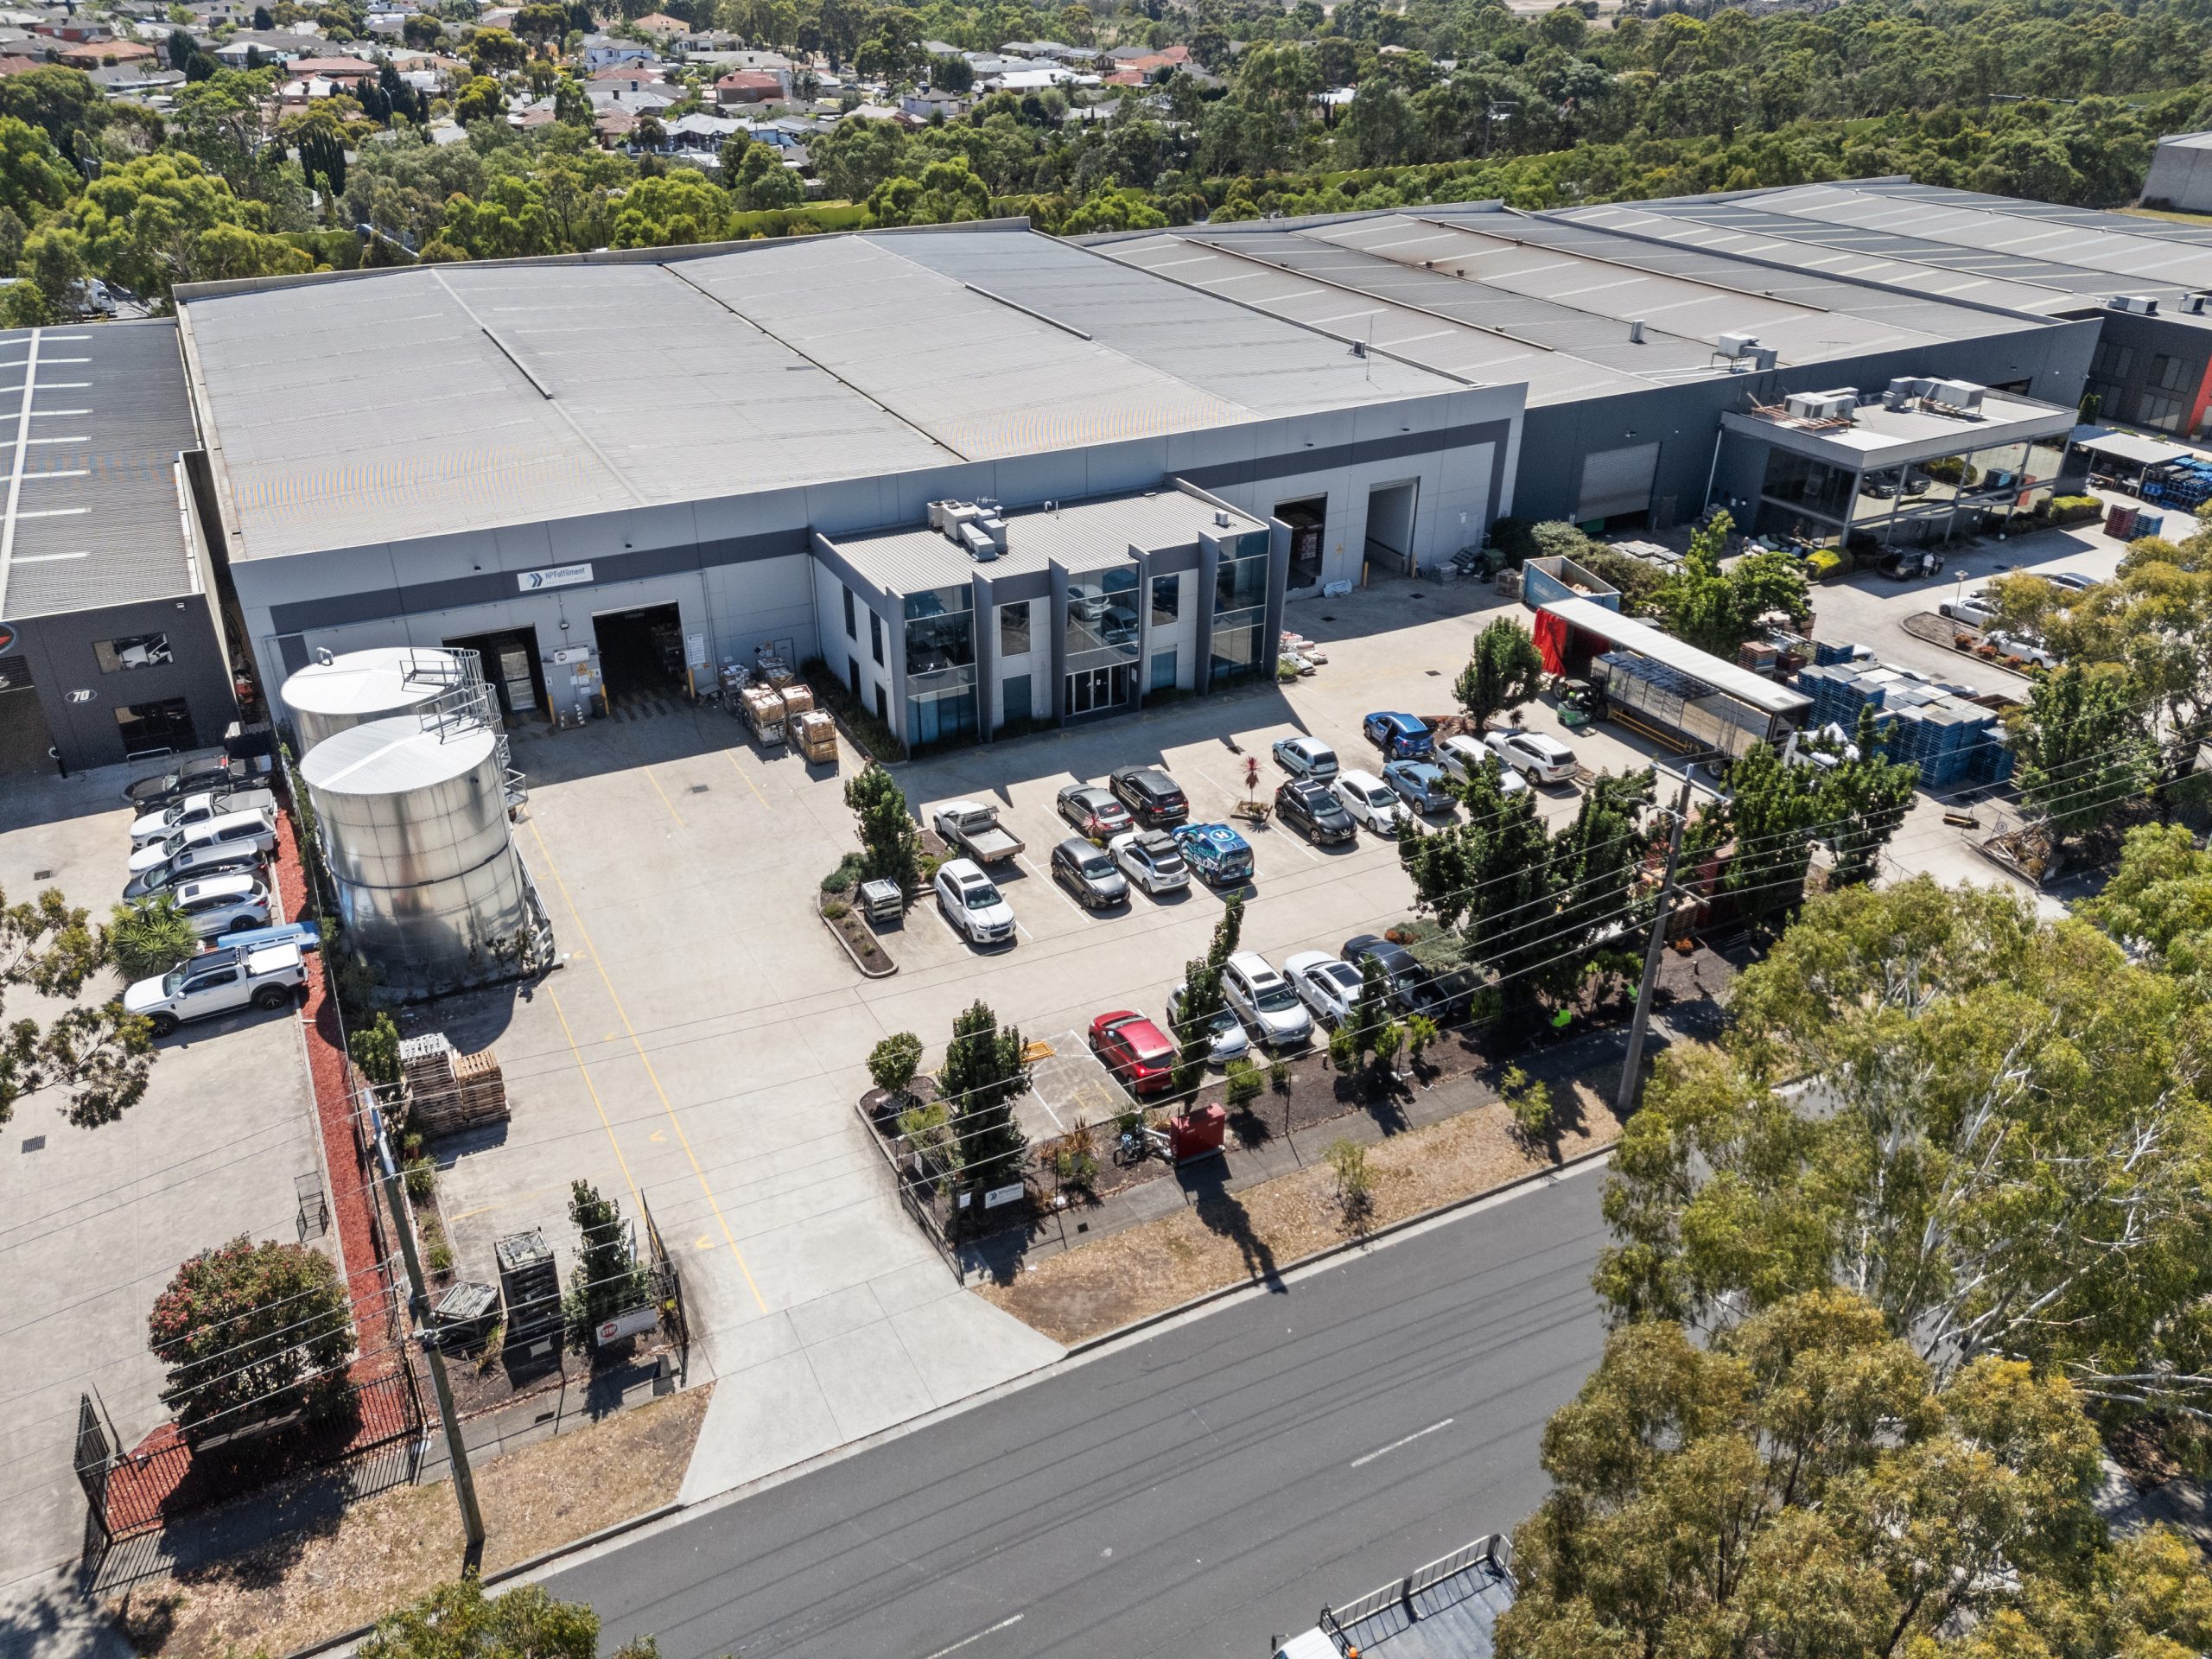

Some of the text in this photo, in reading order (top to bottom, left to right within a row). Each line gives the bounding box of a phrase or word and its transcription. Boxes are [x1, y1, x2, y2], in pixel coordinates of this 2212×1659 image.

[545, 567, 585, 579] NPFulfilment
[73, 690, 90, 702] 70
[1193, 843, 1216, 859] Estate
[1193, 854, 1219, 871] Studios
[601, 1325, 617, 1337] STOP
